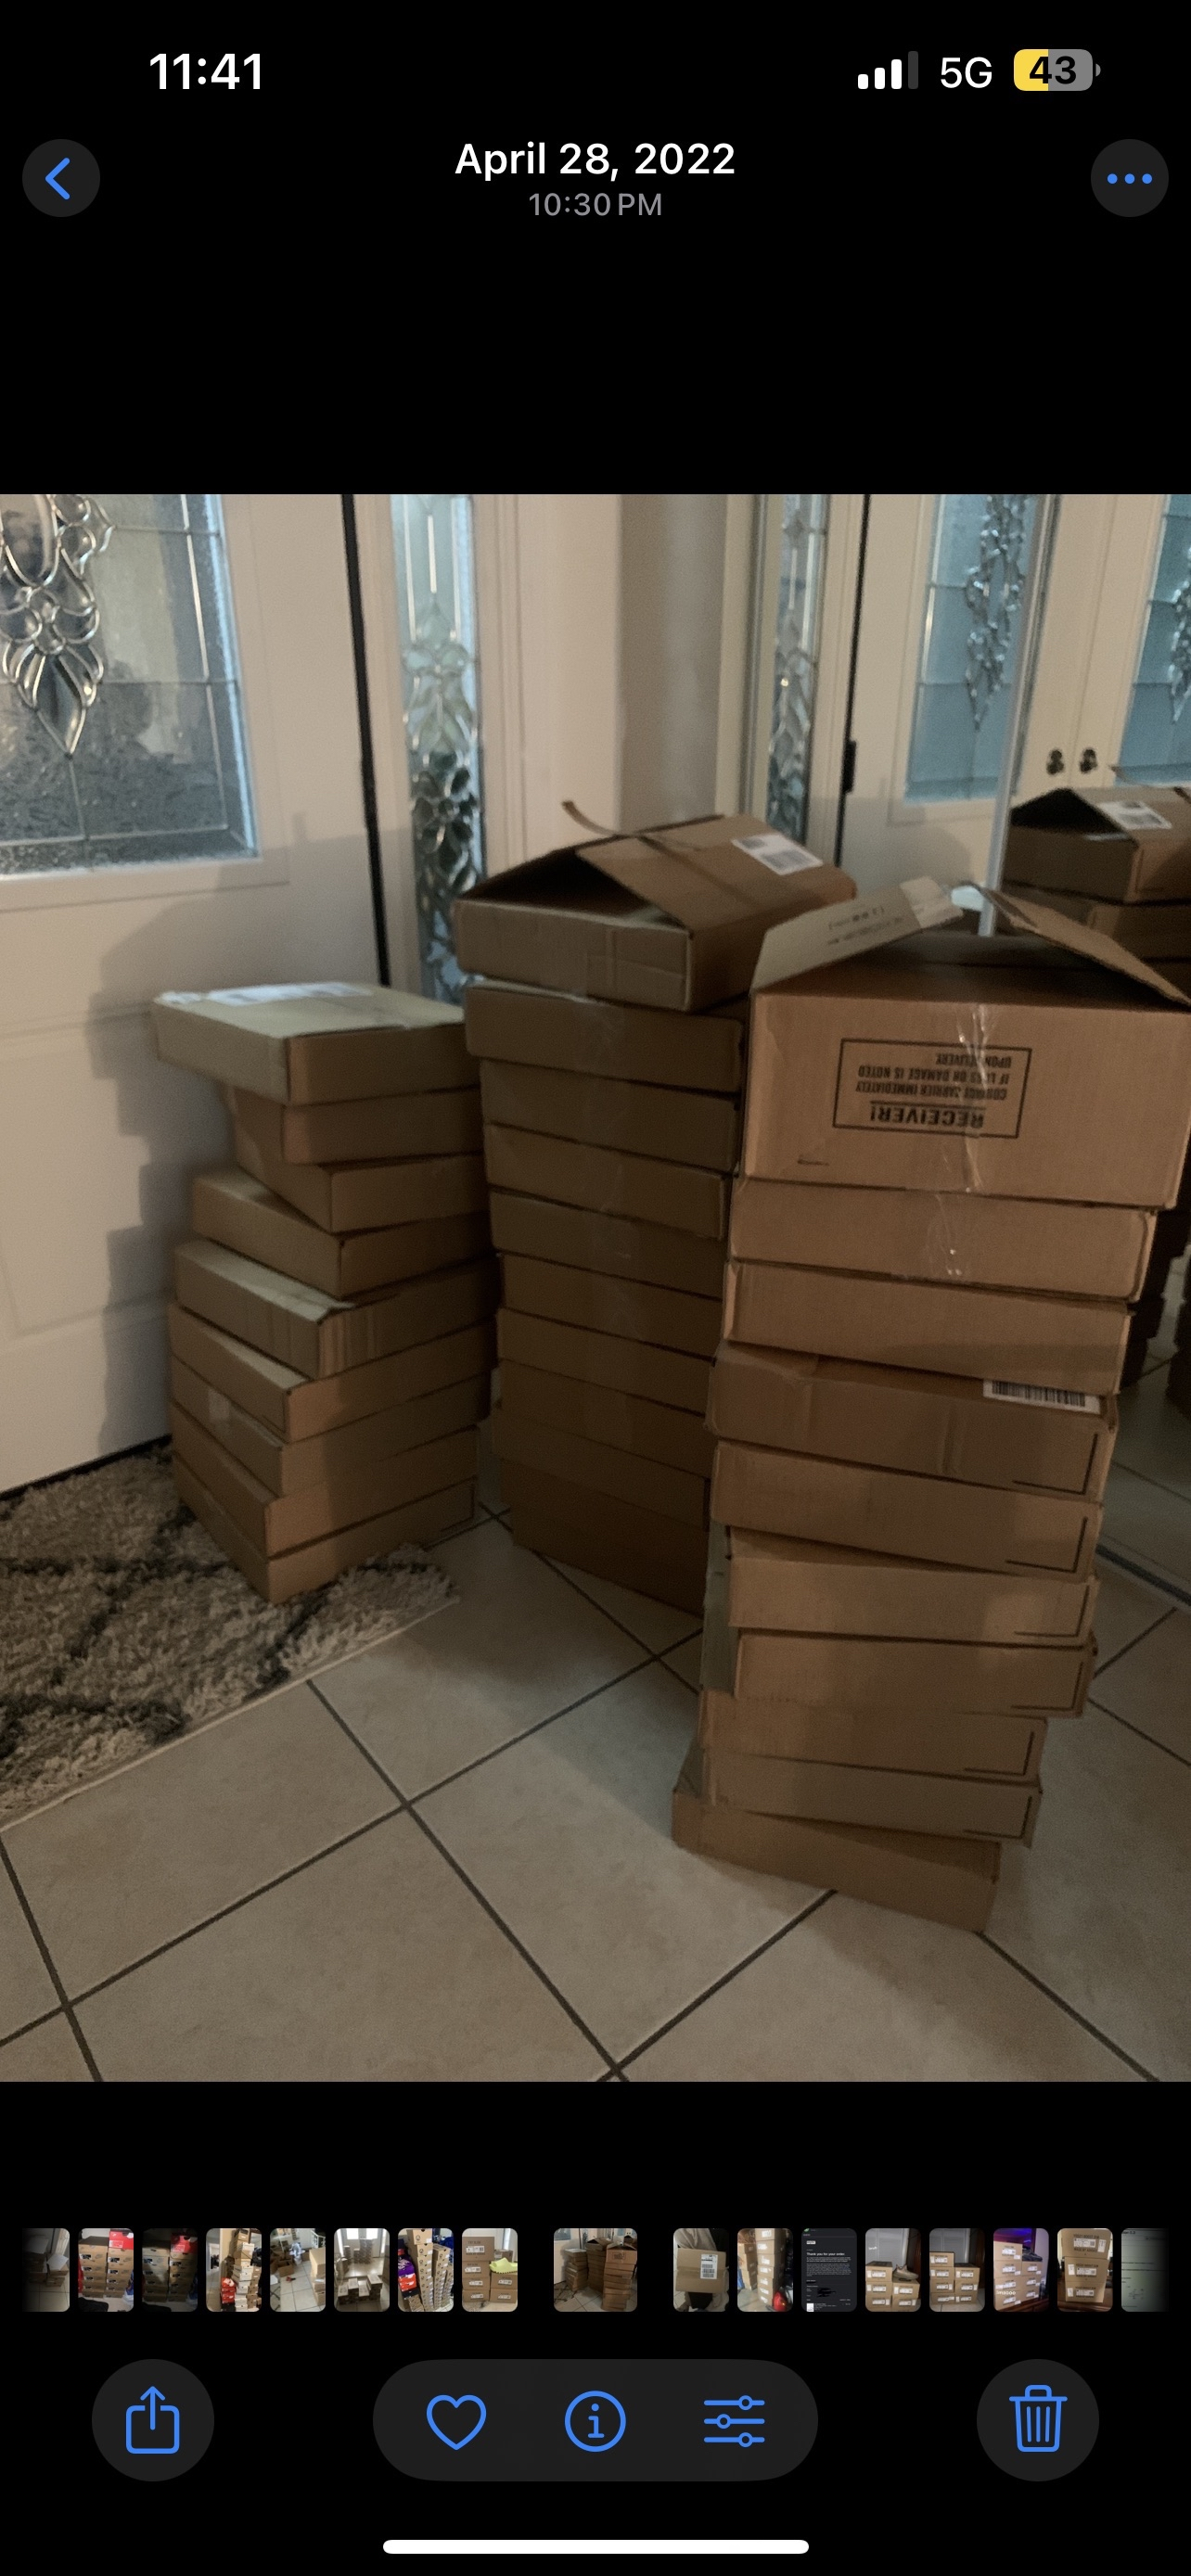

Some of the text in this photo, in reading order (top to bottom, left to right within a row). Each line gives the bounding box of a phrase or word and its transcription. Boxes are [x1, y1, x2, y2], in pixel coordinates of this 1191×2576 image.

[149, 53, 261, 90] 11:41
[940, 56, 992, 89] 5G
[1029, 56, 1077, 84] 43
[455, 140, 736, 183] April 28, 2022
[529, 192, 662, 217] 10:30 PM
[935, 1052, 983, 1067] ELIVERY
[857, 1065, 890, 1078] NOTED
[893, 1065, 904, 1079] IS
[908, 1066, 950, 1082] DAMAGE
[1000, 1073, 1010, 1085] IF
[855, 1080, 918, 1096] IMMEDIATELY
[870, 1104, 984, 1129] RECEIVER!
